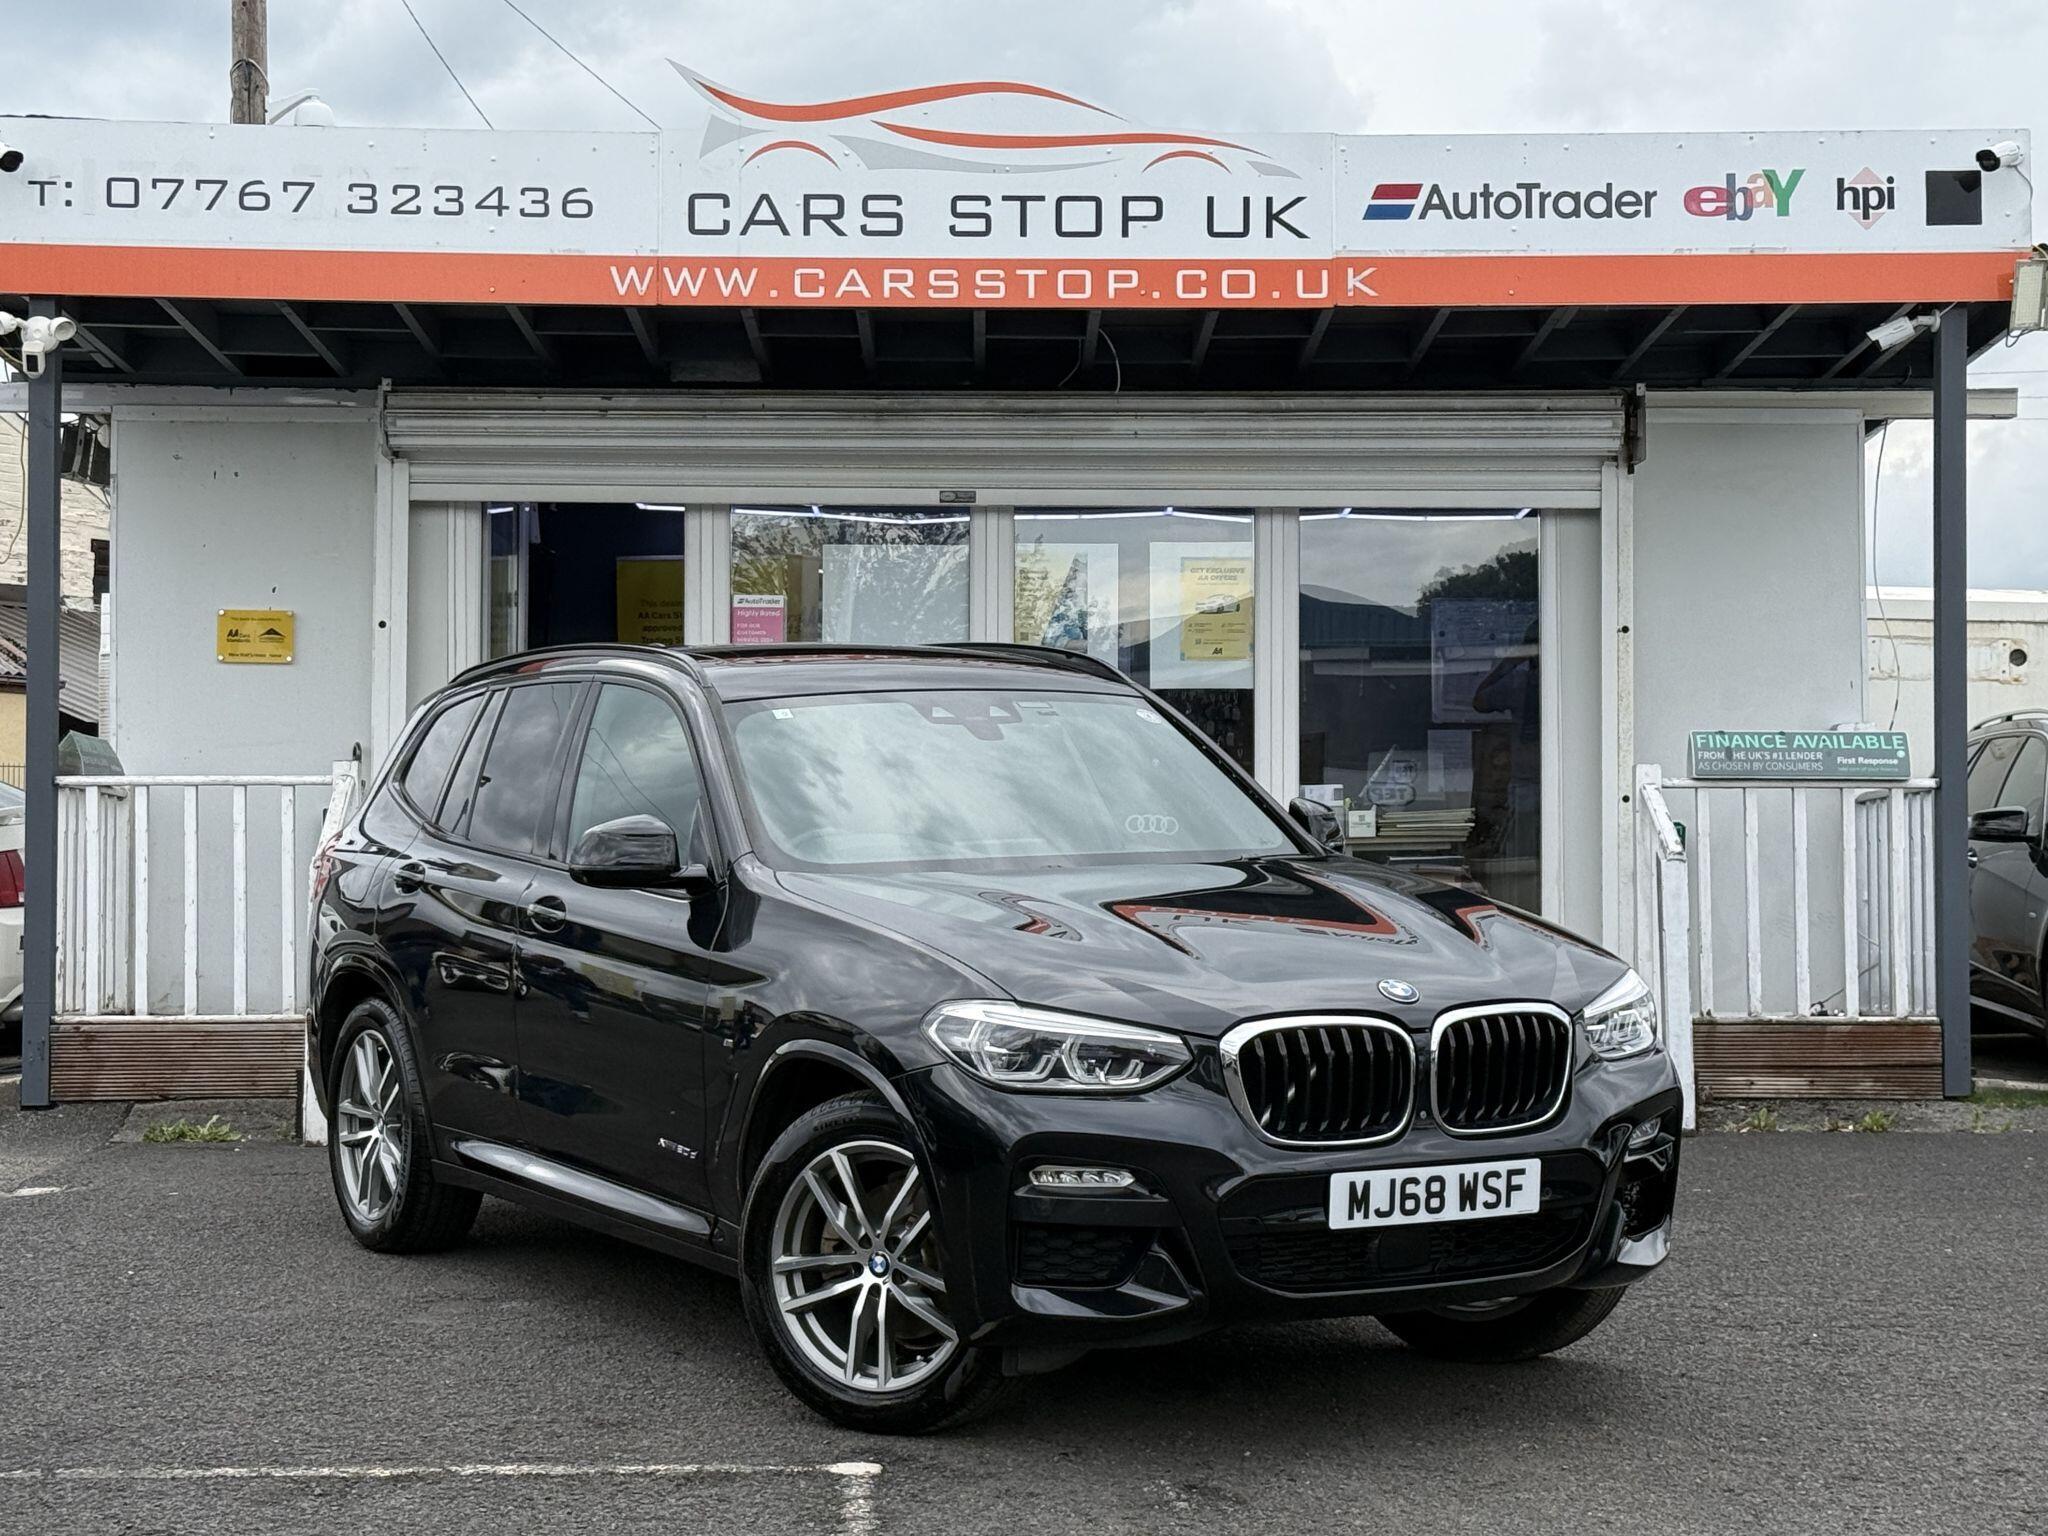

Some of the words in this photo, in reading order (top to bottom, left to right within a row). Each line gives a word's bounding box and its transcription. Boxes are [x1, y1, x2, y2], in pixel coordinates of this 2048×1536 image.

[28, 180, 74, 208] T:
[106, 177, 317, 215] 07767
[347, 182, 595, 220] 323436
[1417, 182, 1659, 221] AutoTrader
[1836, 177, 1896, 213] hpi
[687, 193, 905, 238] CARS
[949, 194, 1166, 239] STOP
[1206, 196, 1311, 241] UK
[609, 265, 1380, 300] WWW.CARSSTOP.CO.UK
[1212, 646, 1224, 656] AA
[1695, 734, 1788, 749] FINANCE
[1793, 734, 1906, 750] AVAILABLE
[1698, 751, 1725, 760] FROM
[1748, 751, 1770, 760] UK'S
[1785, 751, 1823, 761] LENDER
[1698, 761, 1710, 770] AS
[1711, 761, 1751, 771] CHOSEN
[1752, 761, 1764, 771] BY
[1765, 761, 1824, 771] CONSUMERS
[1836, 756, 1857, 765] First
[1858, 757, 1899, 767] Response
[1347, 1174, 1447, 1221] MJ68
[1457, 1167, 1527, 1213] WSF
